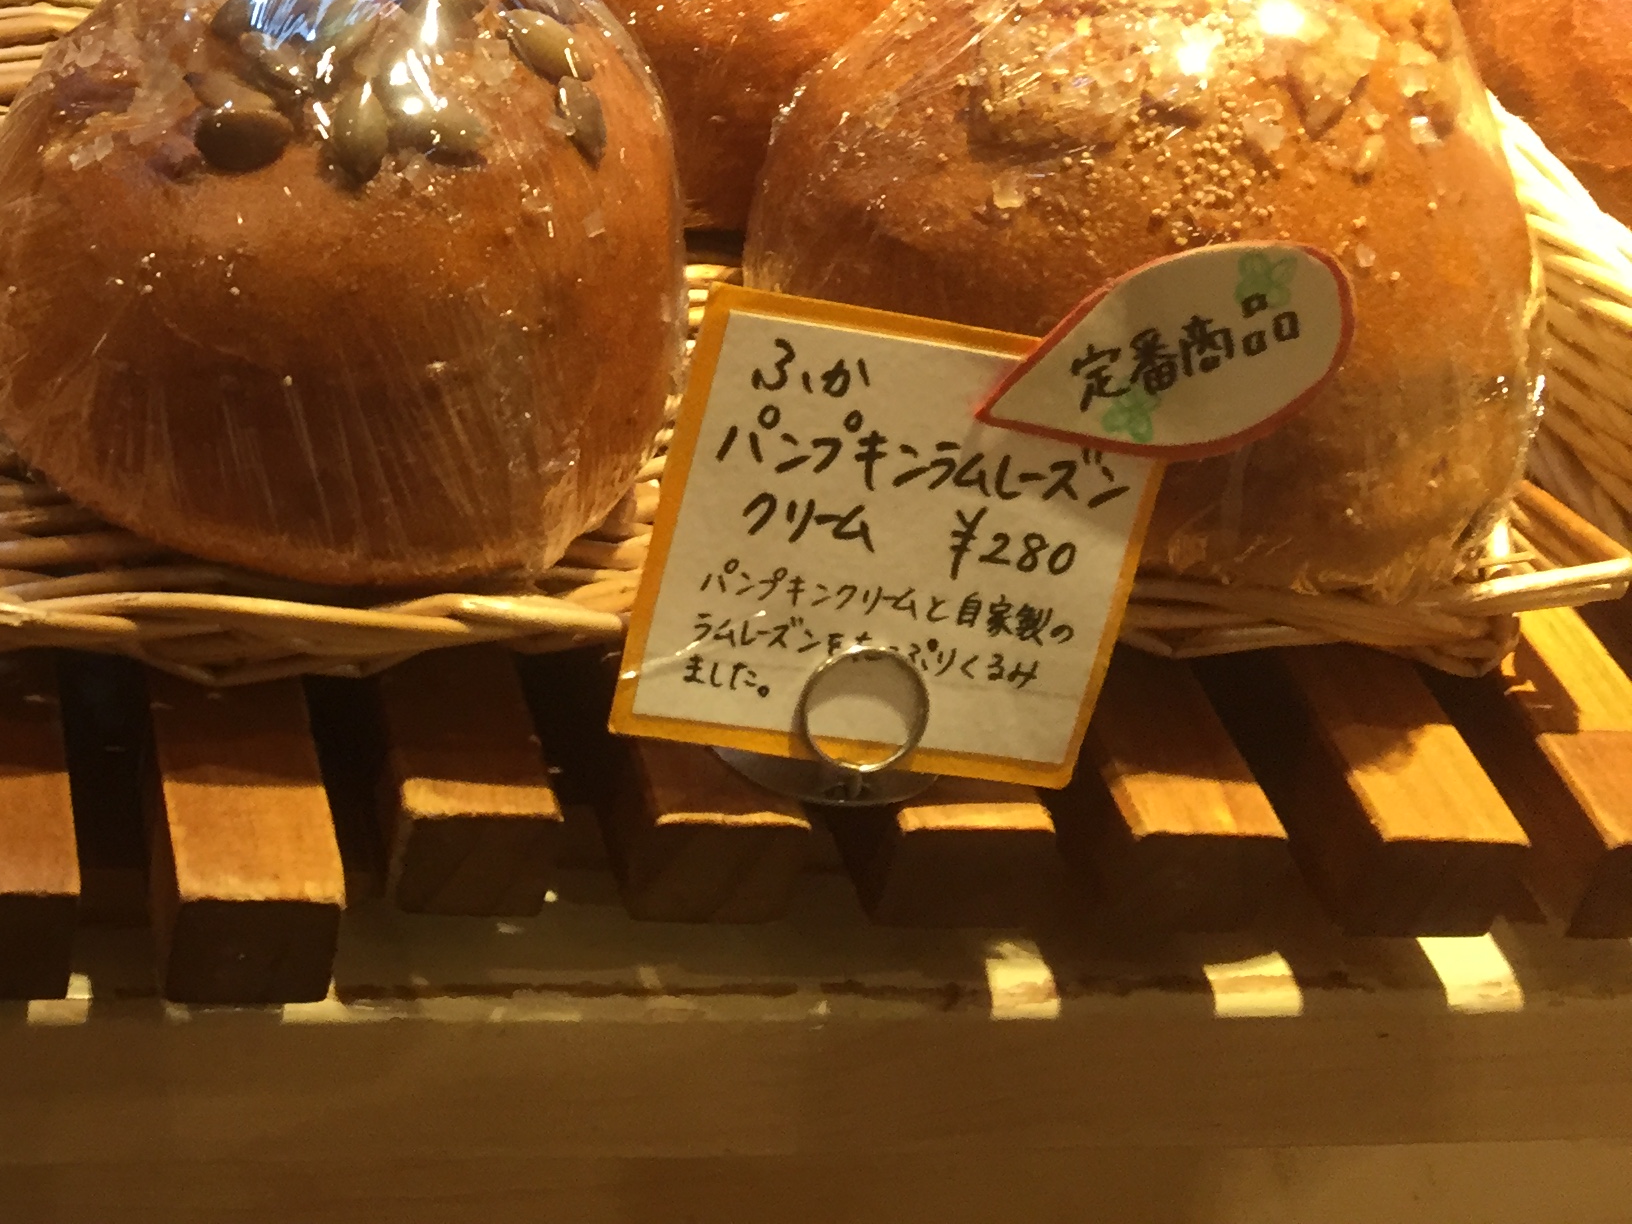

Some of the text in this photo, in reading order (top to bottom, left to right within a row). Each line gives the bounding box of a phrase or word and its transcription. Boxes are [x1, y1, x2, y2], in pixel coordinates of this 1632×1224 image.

[1068, 293, 1301, 412] 定番商品
[715, 404, 1131, 509] パンプキンラムレーズン
[742, 492, 1077, 580] クリーム ¥280
[699, 558, 1075, 646] パンプキンクリームと自家製の
[683, 654, 771, 699] ました。
